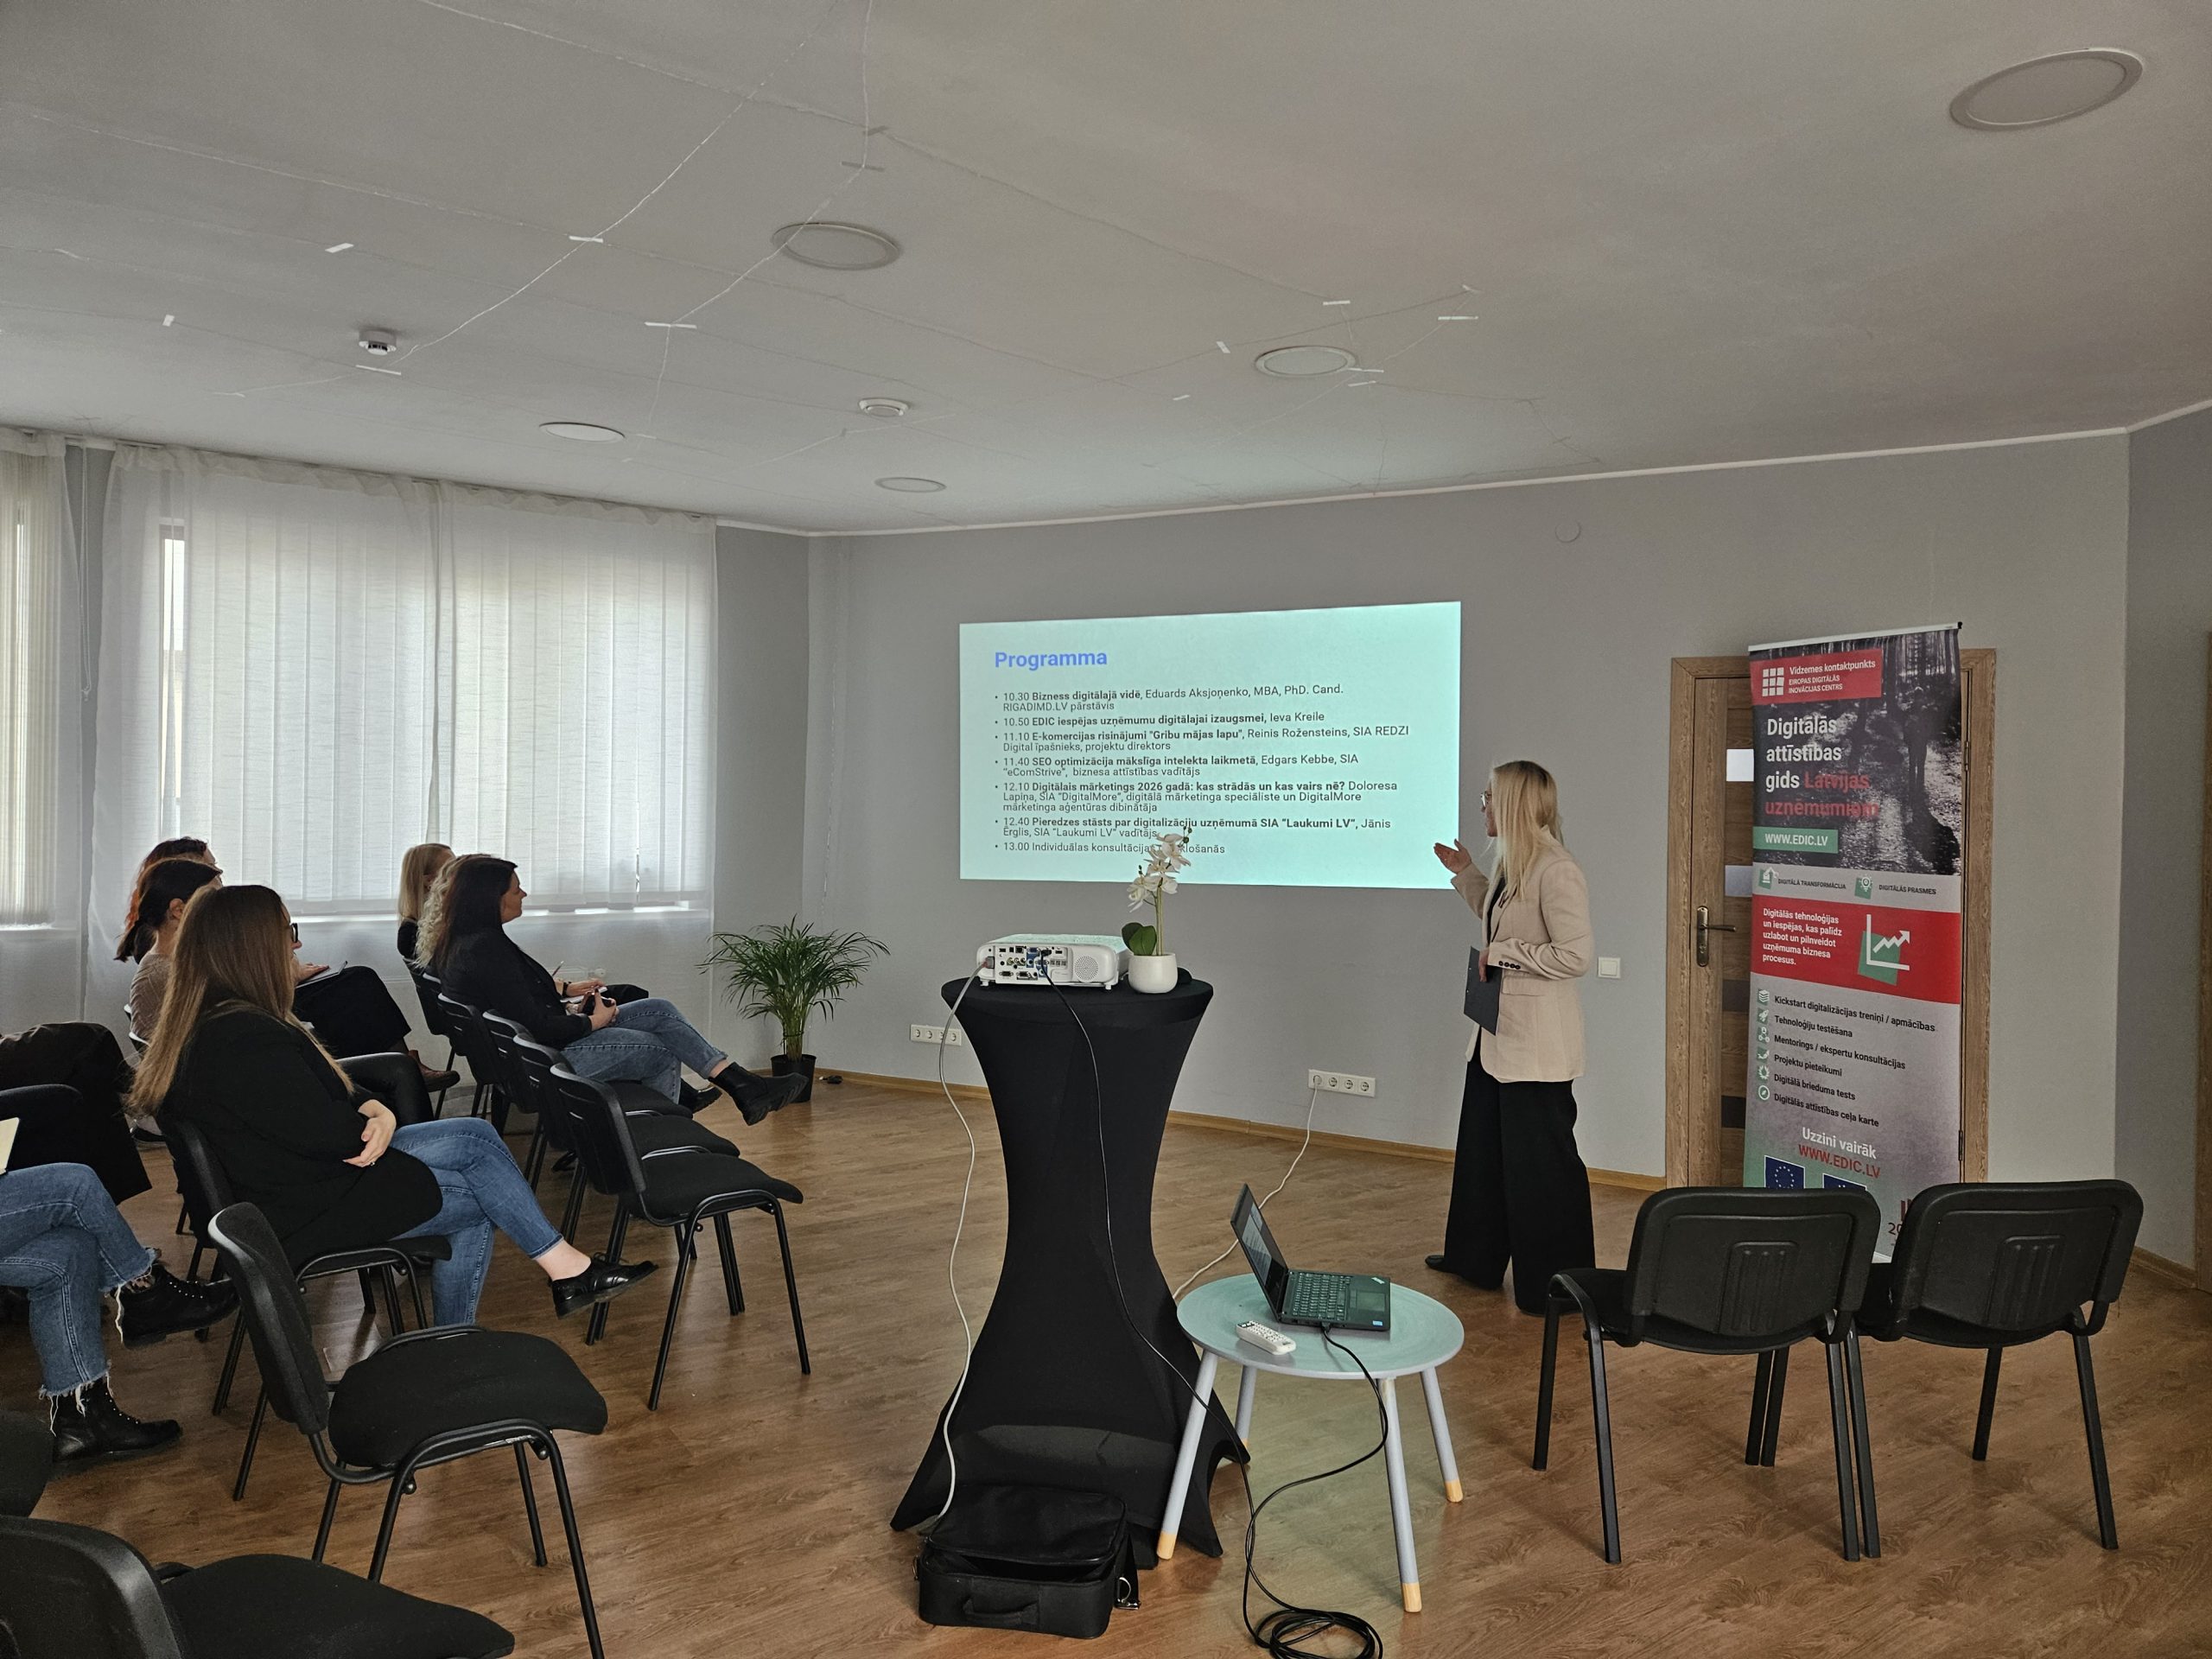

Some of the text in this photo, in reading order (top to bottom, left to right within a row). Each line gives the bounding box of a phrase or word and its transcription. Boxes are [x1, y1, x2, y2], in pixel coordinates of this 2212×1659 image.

[995, 652, 1108, 671] Programma
[1789, 660, 1875, 675] Vidzemes kontaktpunkts
[1789, 675, 1840, 685] EIROPAS DIGITĀLĀS
[1003, 684, 1344, 702] 10.30 Bizness digitālajā vidē, Eduards Aksjoņenko, MBA, PhD. Cand.
[1003, 702, 1114, 712] RIGADIMD.LV pārstāvis
[1003, 712, 1325, 727] 10.50 EDIC iespējas uzņēmumu digitālajai izaugsmei, Ieva Kreile
[1768, 715, 1837, 739] Digitālās
[1032, 732, 1096, 741] E-komercijas
[1097, 731, 1147, 741] risinājumi
[1183, 730, 1213, 741] mājas
[1248, 728, 1279, 738] Reinis
[1282, 728, 1351, 738] Rožensteins,
[1353, 727, 1371, 736] SIA
[1376, 727, 1408, 735] REDZI
[1003, 742, 1171, 753] Digital īpašnieks, projektu direktors
[1766, 743, 1841, 762] attīstības
[1003, 758, 1030, 766] 11.40
[1055, 758, 1114, 767] optimizācija
[1116, 758, 1161, 767] mākslīga
[1164, 757, 1208, 766] intelekta
[1211, 755, 1258, 766] laikmetā,
[1262, 755, 1297, 766] Edgars
[1300, 754, 1337, 766] Kebbe,
[1340, 754, 1358, 764] SIA
[1073, 767, 1109, 776] biznesa
[1113, 767, 1159, 776] attīstības
[1161, 767, 1200, 777] vadītājs
[1032, 782, 1077, 793] Digitālais
[1080, 782, 1135, 793] mārketings
[1137, 782, 1162, 791] 2026
[1166, 782, 1193, 793] gadā:
[1196, 782, 1214, 791] kas
[1217, 782, 1255, 791] strādās
[1275, 782, 1293, 791] kas
[1297, 782, 1322, 791] vairs
[1325, 782, 1344, 791] nē?
[1348, 781, 1397, 791] Doloresa
[1766, 771, 1870, 793] gids Latvijas
[1003, 793, 1037, 803] Lapiņa,
[1039, 792, 1055, 801] SIA
[1126, 792, 1161, 803] digitālā
[1165, 792, 1221, 803] mārketinga
[1224, 792, 1280, 803] speciāliste
[1299, 792, 1362, 803] DigitalMore
[1003, 803, 1157, 813] mārketinga aģentūras dibinātāja
[1765, 798, 1879, 820] uzņēmumiem
[1003, 817, 1030, 826] 12.40
[1032, 817, 1080, 826] Pieredzes
[1115, 819, 1132, 829] par
[1134, 818, 1198, 829] digitalizāciju
[1200, 819, 1257, 830] uzņēmumā
[1261, 819, 1279, 828] SIA
[1361, 819, 1391, 828] Jānis
[1003, 826, 1032, 837] Ērglis,
[1034, 828, 1050, 836] SIA
[1119, 828, 1157, 838] vadītājs
[1765, 833, 1828, 846] WWW.EDIC.LV
[1003, 842, 1030, 851] 13.00
[1032, 842, 1089, 851] Individuālas
[1091, 842, 1152, 854] konsultācija
[1778, 878, 1800, 887] DIGITĀLĀ
[1879, 884, 1906, 893] DIGITĀLĀS
[1764, 908, 1839, 925] Digitālās tehnoloģijas
[1773, 921, 1804, 932] iespējas,
[1821, 926, 1842, 936] palīdz
[1764, 931, 1788, 941] uzlabot
[1801, 936, 1836, 947] pilnveidot
[1764, 943, 1831, 958] uzņēmuma biznesa
[1763, 955, 1796, 964] procesus.
[1775, 995, 1806, 1008] Kickstart
[1808, 1001, 1857, 1018] digitalizācijas
[1859, 1012, 1884, 1023] treniņi
[1891, 1017, 1936, 1032] apmācības
[1775, 1015, 1853, 1037] Tehnoloģiju testēšana
[1774, 1035, 1814, 1050] Mentorings
[1820, 1045, 1853, 1058] ekspertu
[1854, 1051, 1905, 1069] konsultācijas
[1774, 1055, 1842, 1077] Projektu pieteikumi
[1774, 1074, 1856, 1100] Digitālā brieduma tests
[1774, 1093, 1878, 1127] Digitālās attīstības ceļa karte
[1802, 1127, 1877, 1159] Uzzini vairāk
[1799, 1144, 1880, 1179] WWW.EDIC.LV
